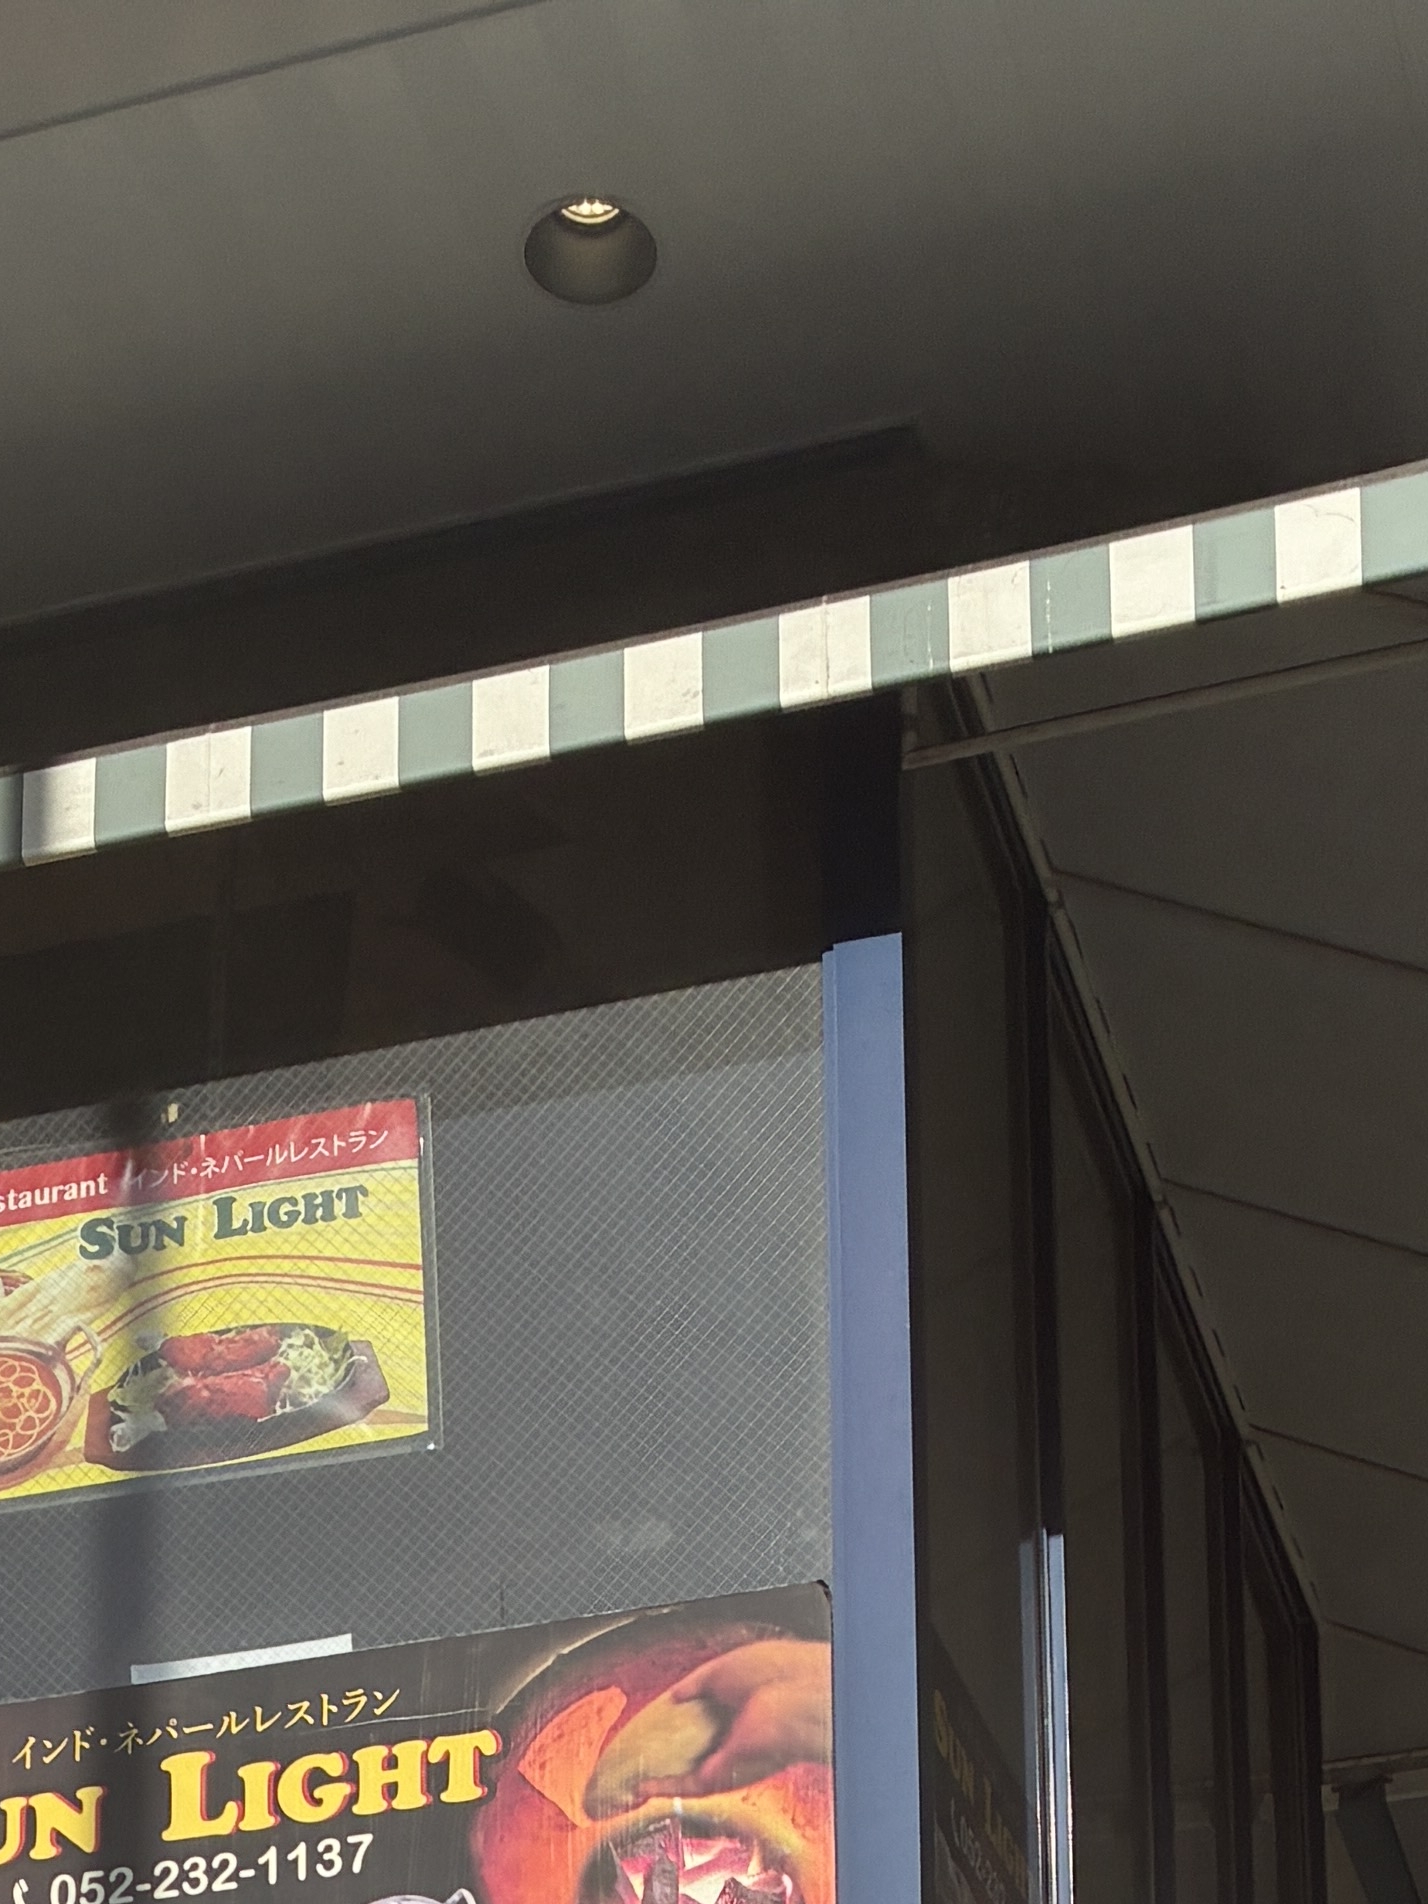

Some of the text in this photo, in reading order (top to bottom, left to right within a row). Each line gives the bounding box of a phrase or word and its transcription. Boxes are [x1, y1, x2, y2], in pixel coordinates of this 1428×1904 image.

[78, 1183, 370, 1261] SUN LIGHT
[11, 1687, 402, 1771] インド・ネパールレストラン
[160, 1729, 503, 1842] LIGHT
